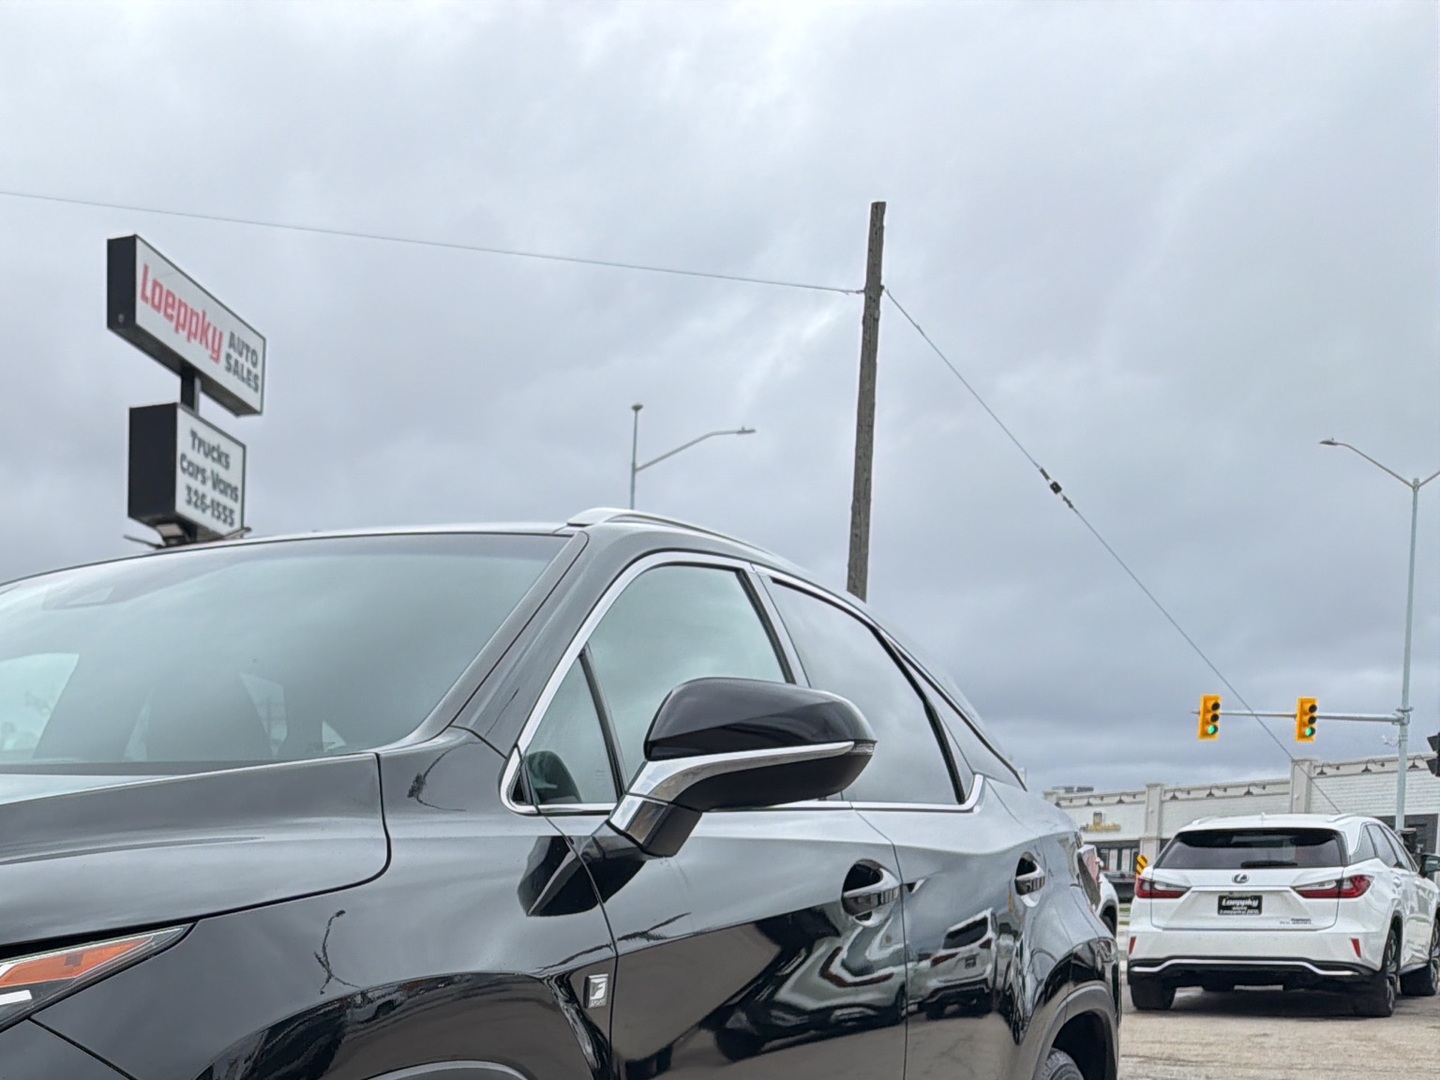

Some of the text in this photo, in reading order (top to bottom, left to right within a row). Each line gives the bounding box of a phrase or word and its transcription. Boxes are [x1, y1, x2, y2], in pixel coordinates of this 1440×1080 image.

[140, 263, 224, 365] Loeppky
[228, 331, 258, 369] AUTO
[225, 352, 260, 394] SALES
[190, 428, 230, 470] Trucks
